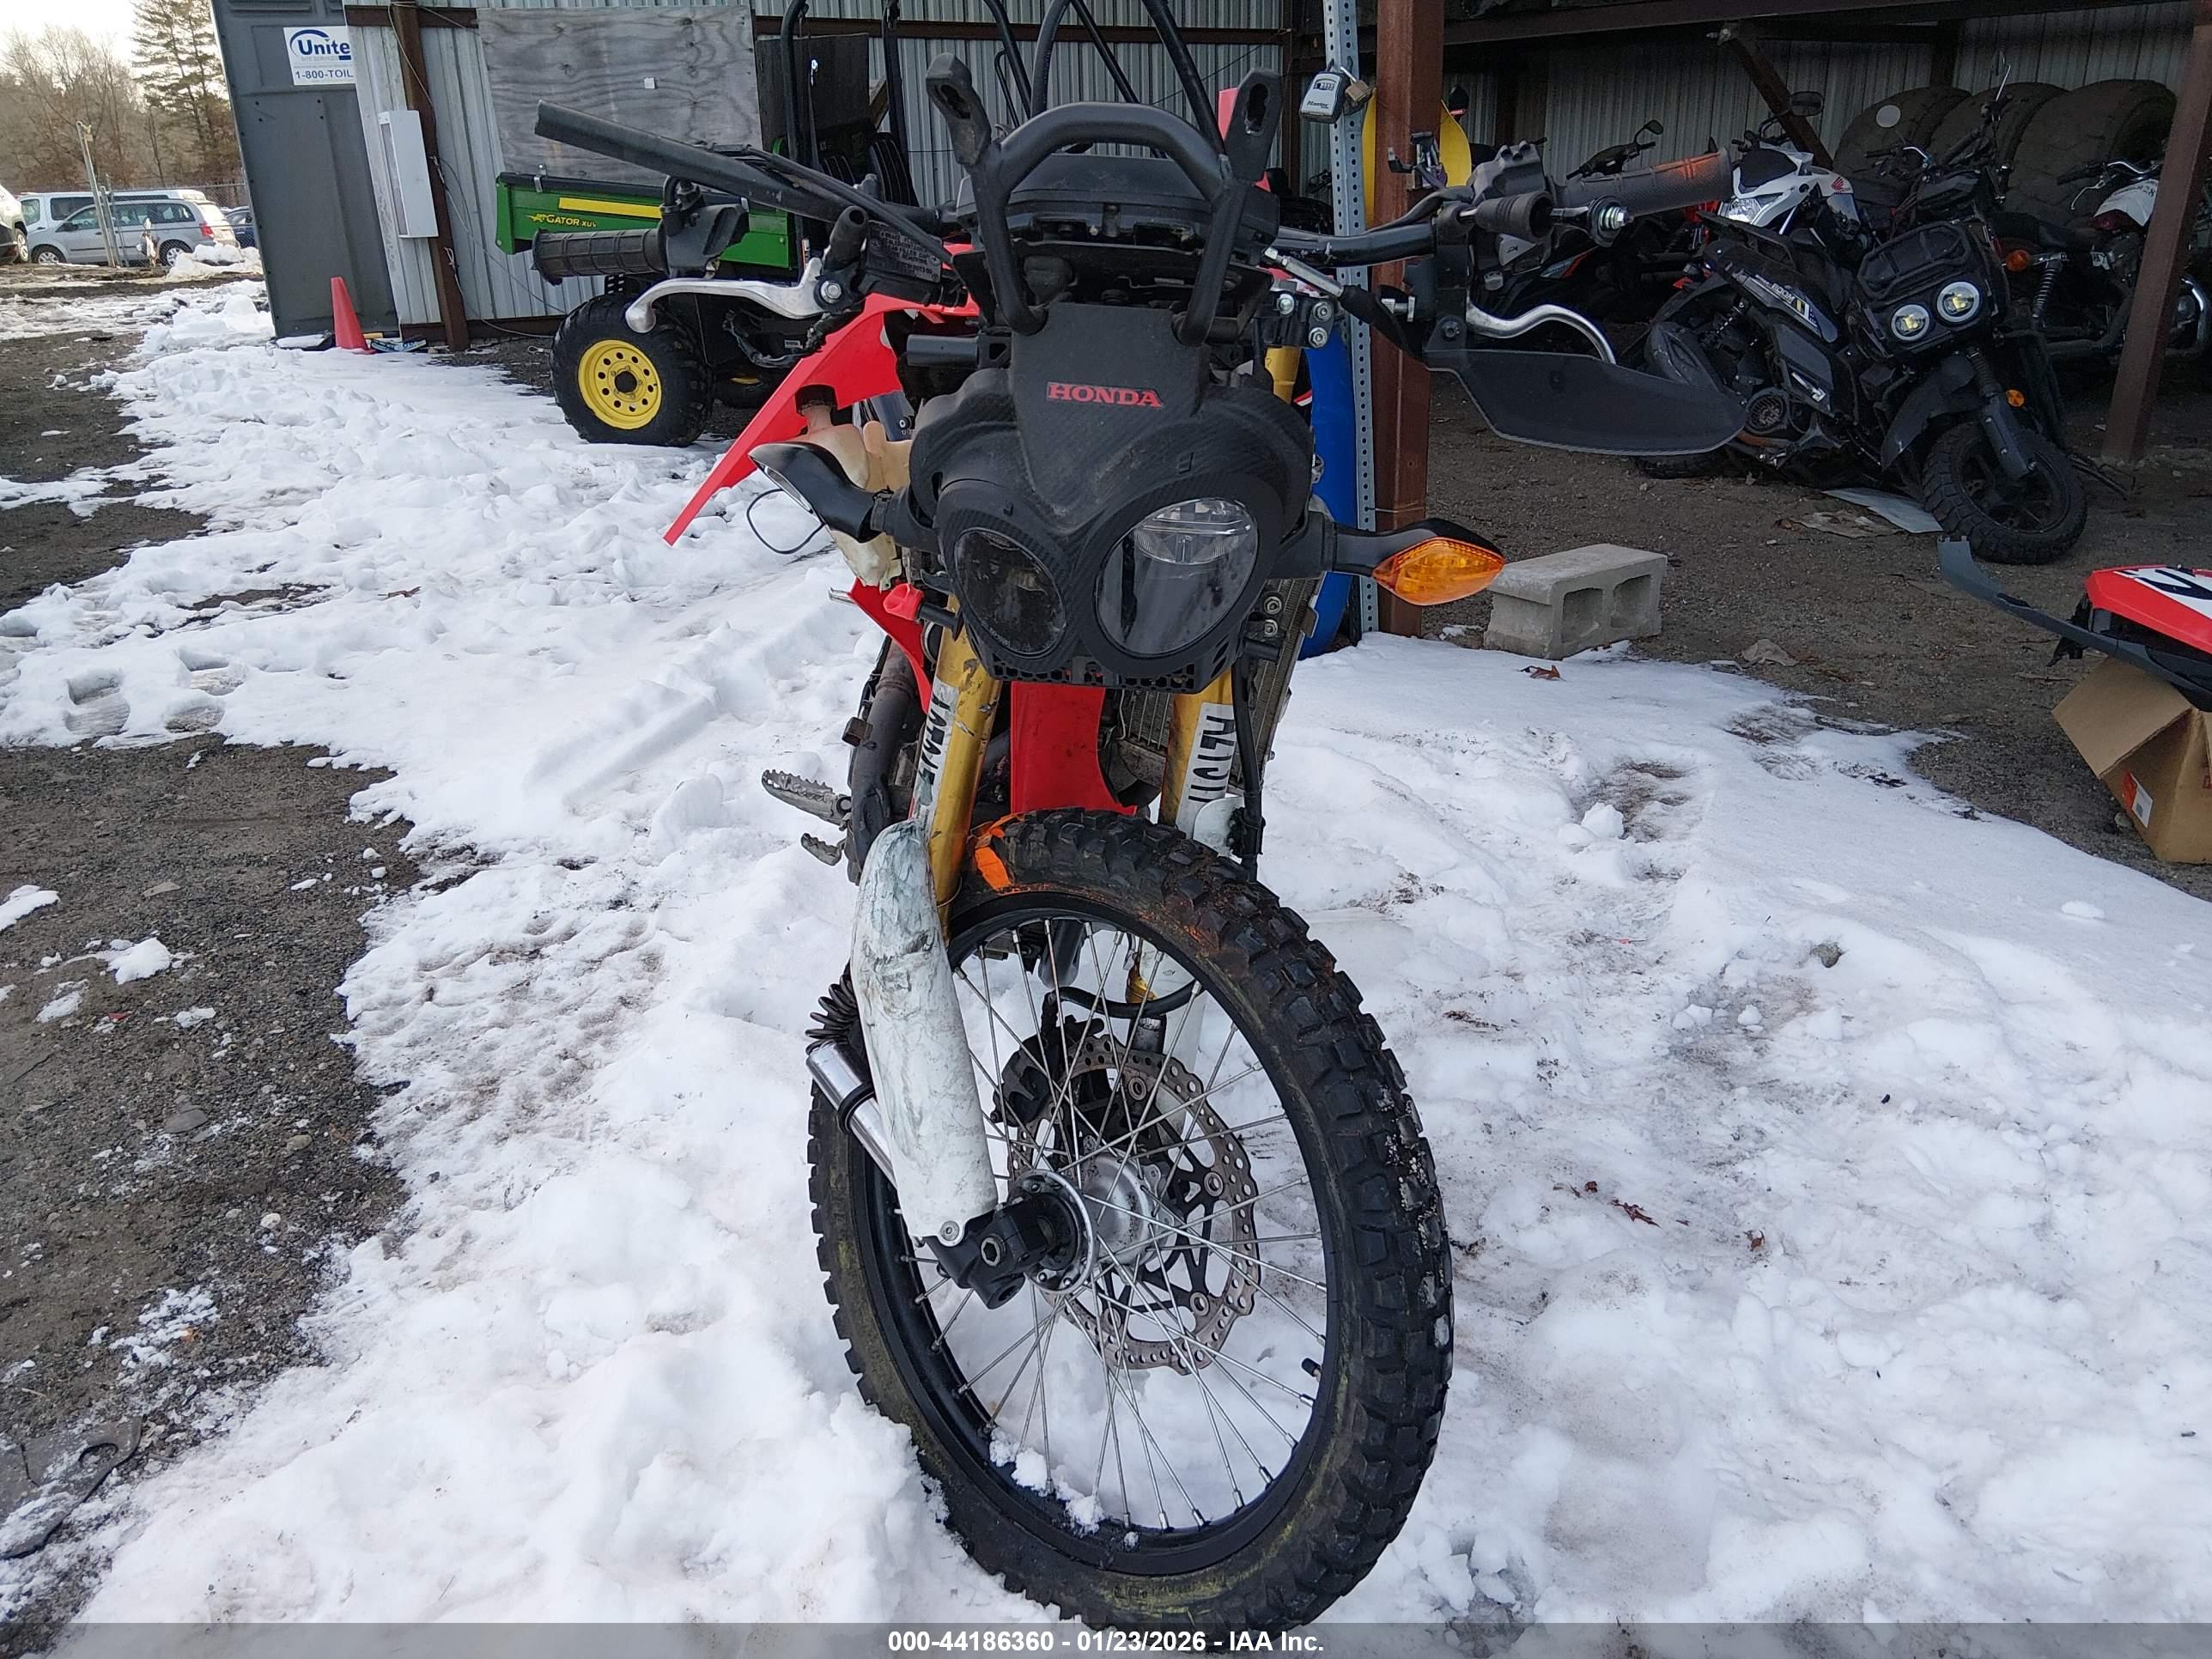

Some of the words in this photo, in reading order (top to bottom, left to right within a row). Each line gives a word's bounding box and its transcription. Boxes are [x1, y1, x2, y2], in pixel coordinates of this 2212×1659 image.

[297, 39, 351, 56] Unite
[295, 69, 355, 79] 1-800-TOIL
[546, 214, 580, 227] GATOR
[1048, 383, 1163, 409] HONDA
